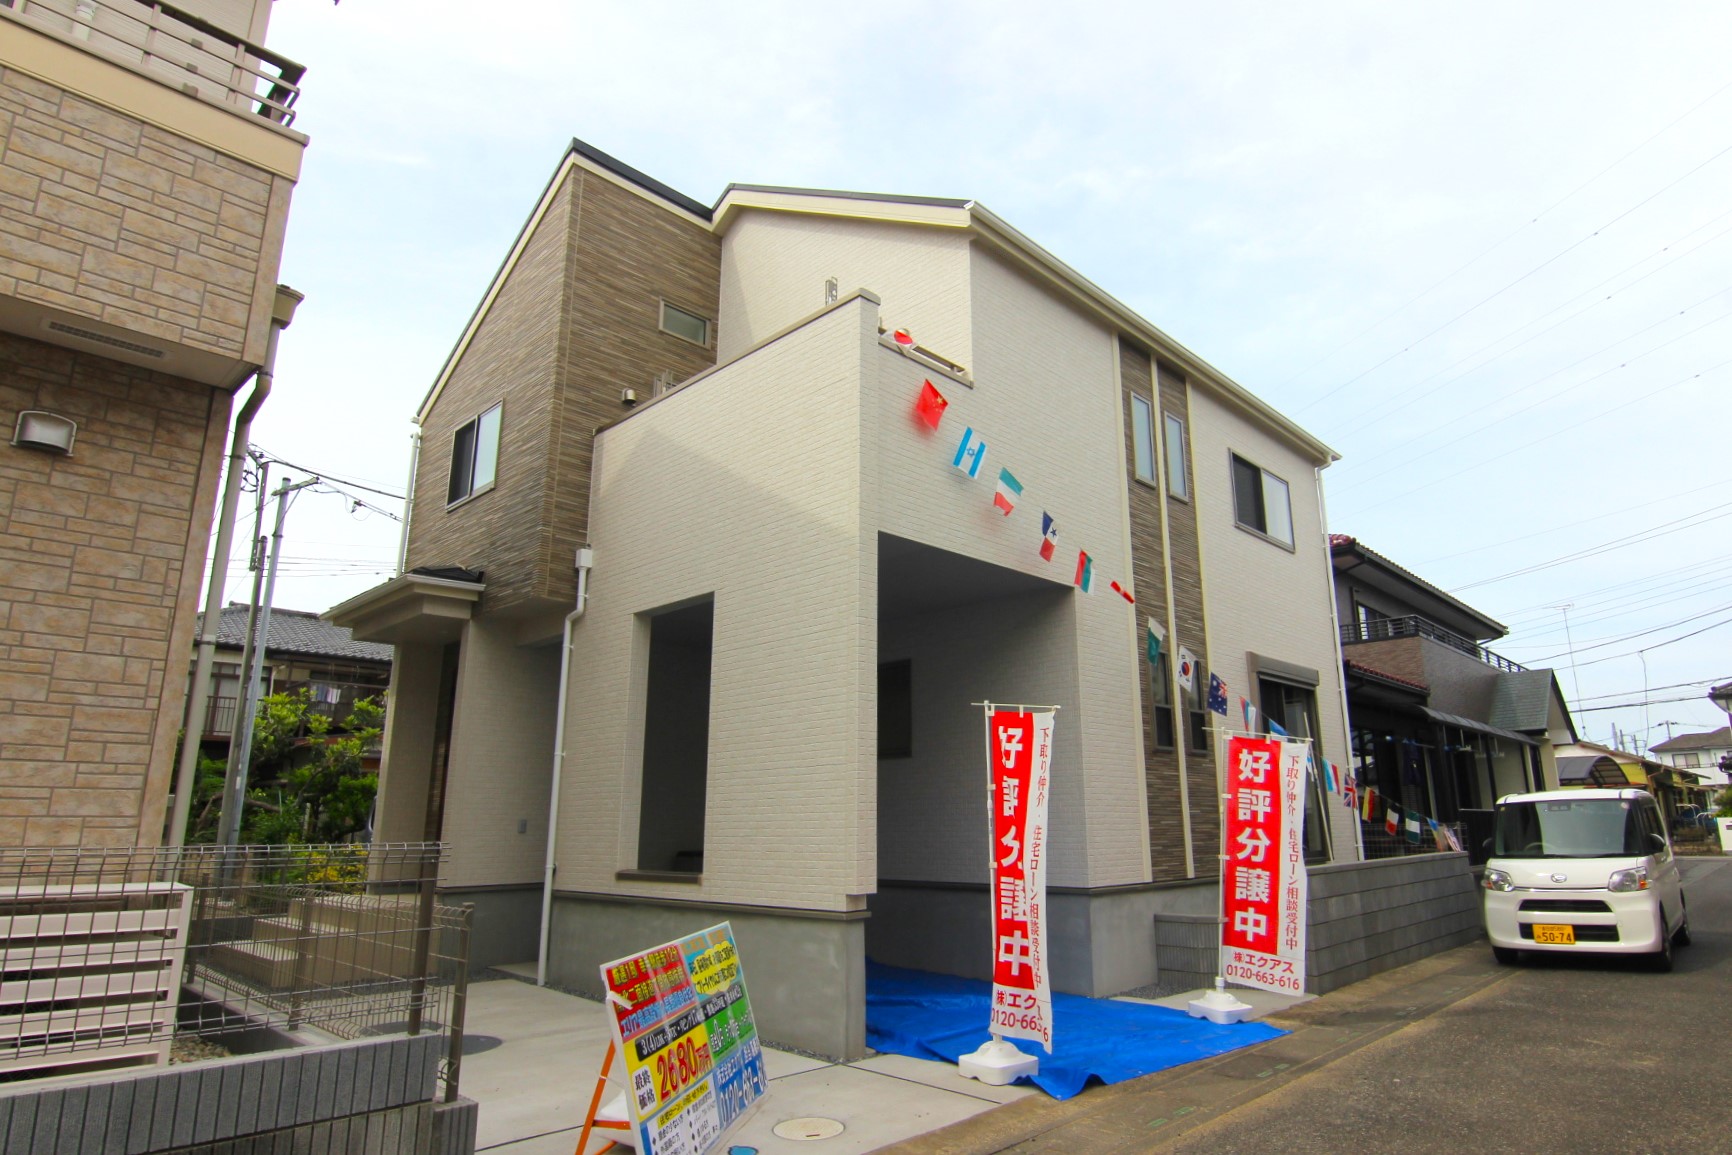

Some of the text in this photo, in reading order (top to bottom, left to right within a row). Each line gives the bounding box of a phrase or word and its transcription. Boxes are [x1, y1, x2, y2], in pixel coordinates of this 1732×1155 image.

[1234, 749, 1271, 942] 好評分譲中
[1542, 932, 1572, 942] 50-74
[1226, 964, 1299, 990] 0120-663-616
